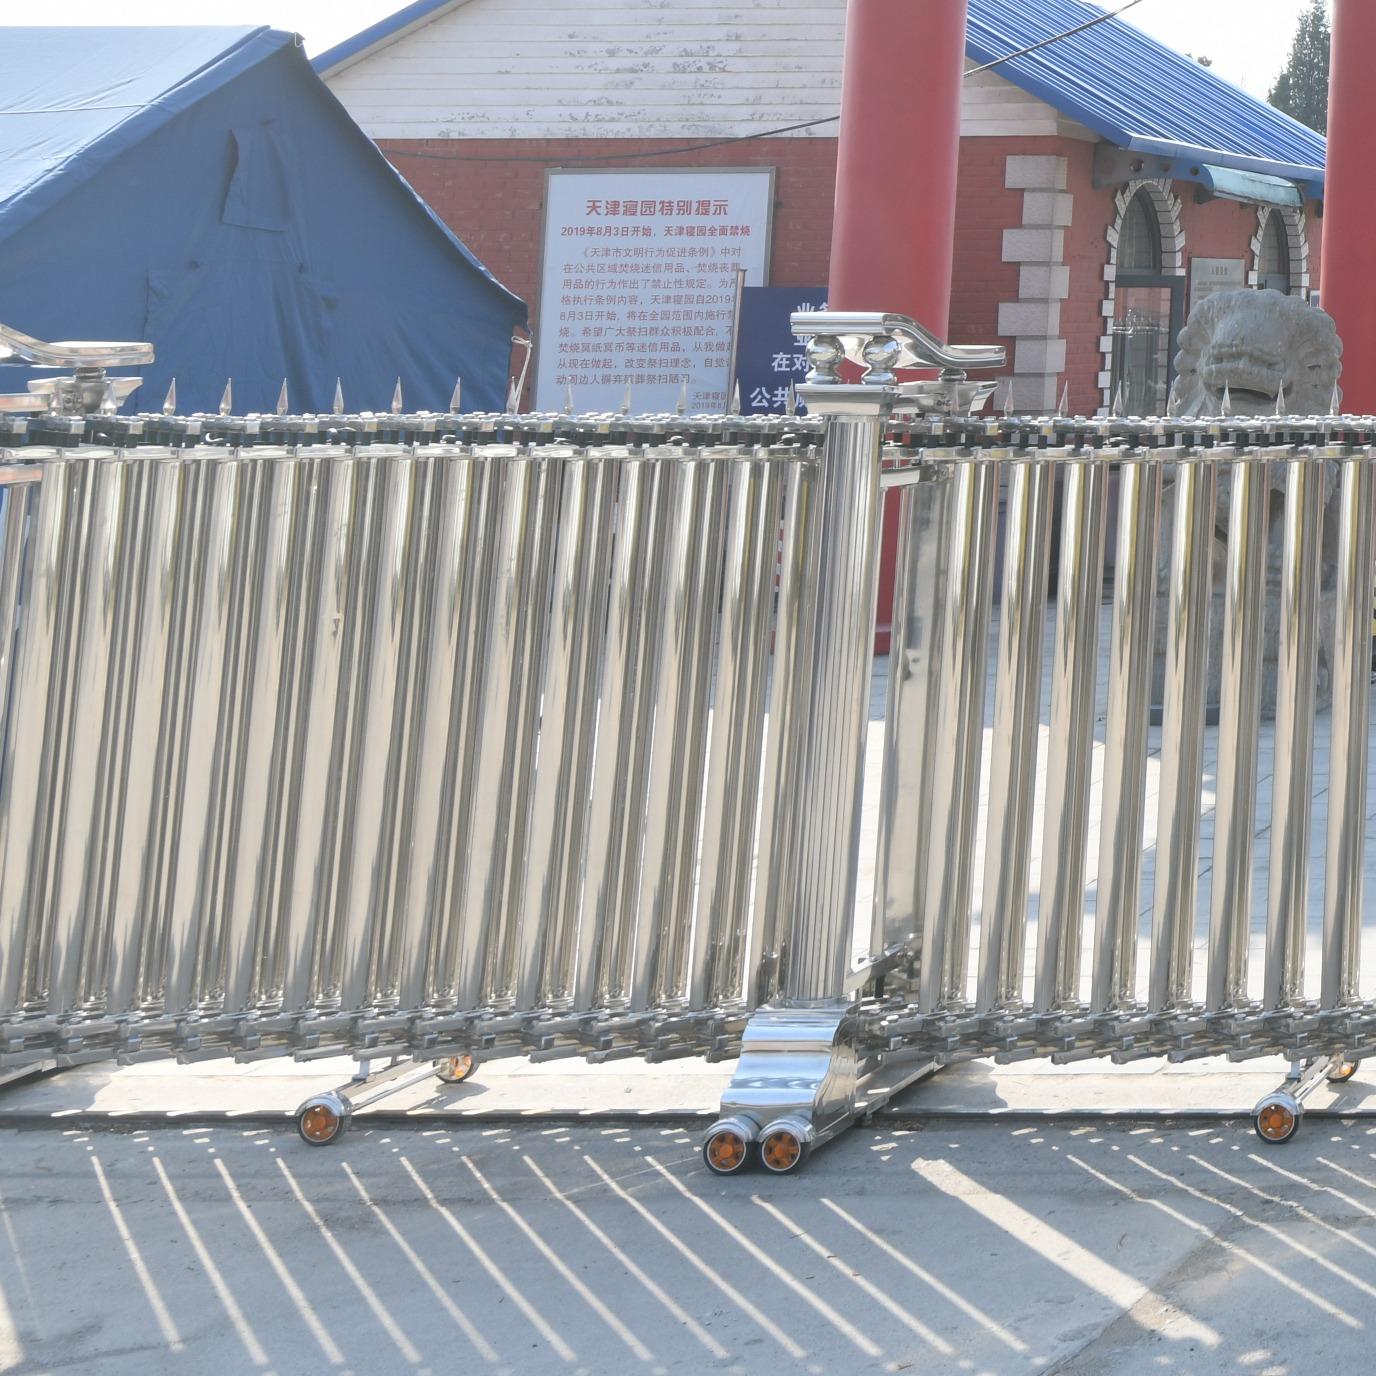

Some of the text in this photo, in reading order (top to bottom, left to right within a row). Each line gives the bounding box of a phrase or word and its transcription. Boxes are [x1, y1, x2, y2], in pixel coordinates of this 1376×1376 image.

[585, 199, 729, 217] 天津寝园特别提示
